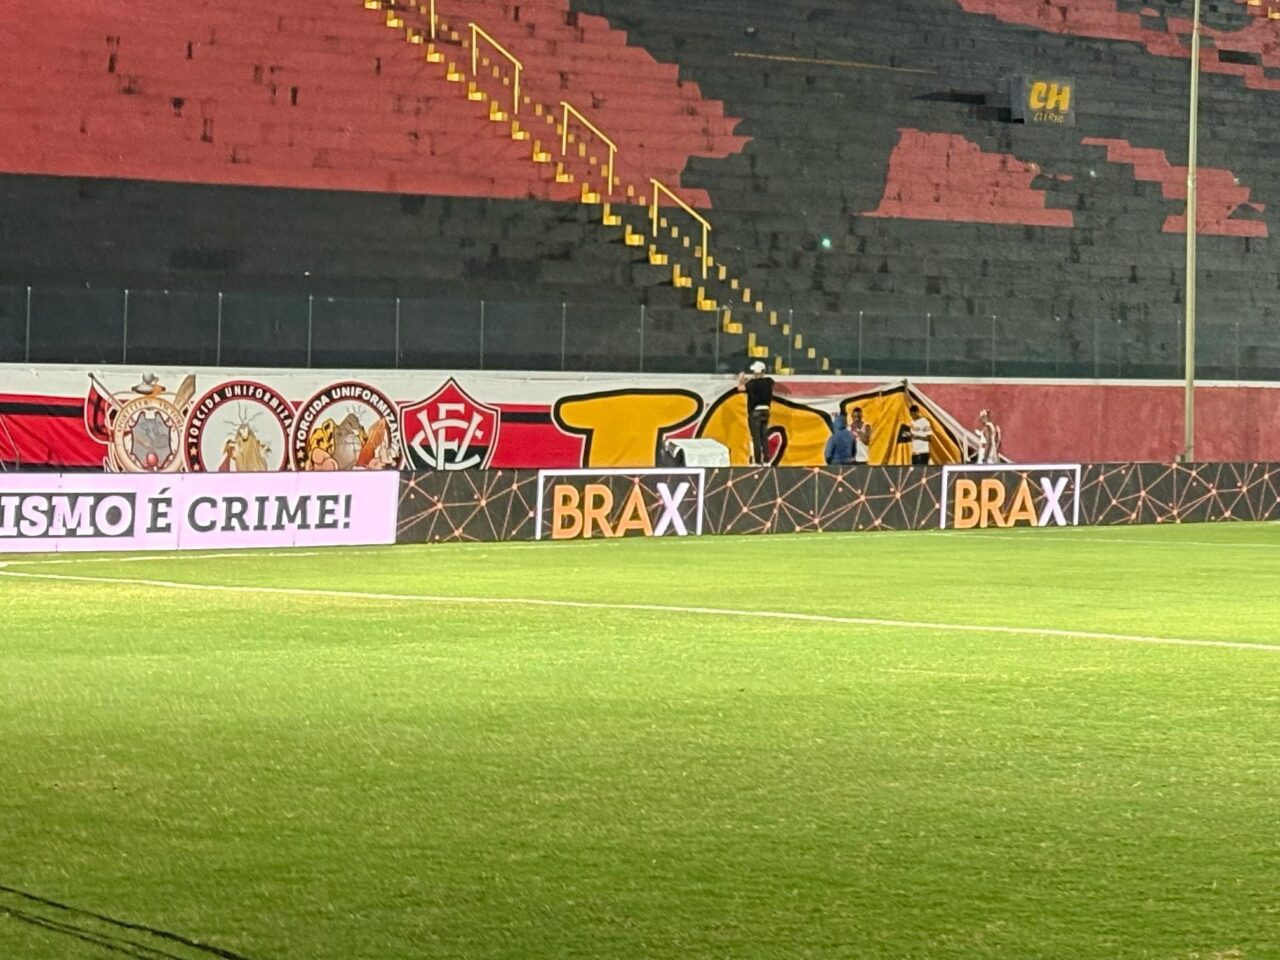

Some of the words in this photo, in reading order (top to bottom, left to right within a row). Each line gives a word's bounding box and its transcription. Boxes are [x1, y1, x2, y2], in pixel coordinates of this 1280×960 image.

[1030, 82, 1070, 111] CH
[188, 392, 221, 444] TORCIDA
[296, 395, 330, 449] TORCIDA
[0, 496, 133, 536] ISMO
[146, 488, 172, 533] É
[187, 495, 353, 533] CRIME!
[552, 482, 690, 539] BRAX
[954, 477, 1069, 529] BRAX
